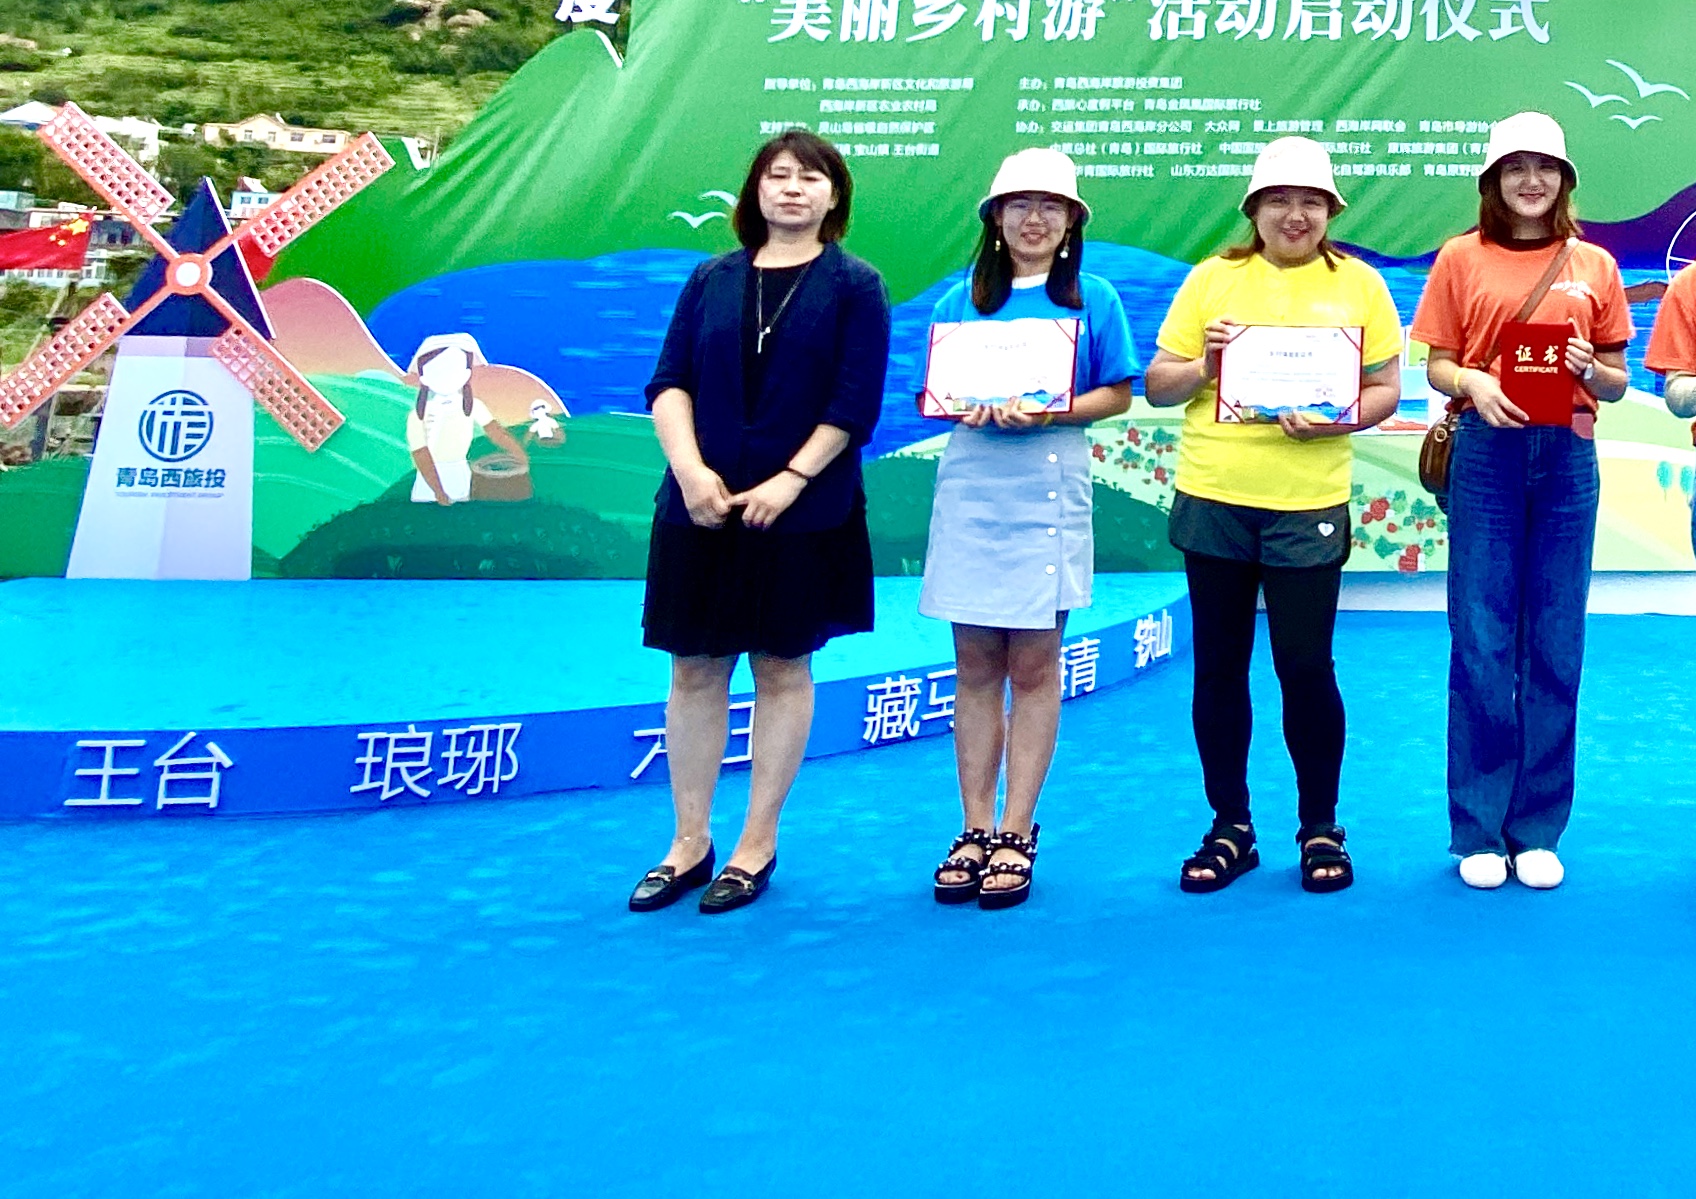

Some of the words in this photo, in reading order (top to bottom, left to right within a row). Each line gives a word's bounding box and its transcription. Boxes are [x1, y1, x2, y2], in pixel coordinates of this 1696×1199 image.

[1205, 120, 1240, 133] 大众网
[1515, 344, 1559, 364] 证书
[1514, 365, 1559, 374] CERTIFICATE
[116, 467, 227, 488] 青岛西旅投
[64, 731, 234, 810] 王台
[350, 722, 523, 801] 琅琊
